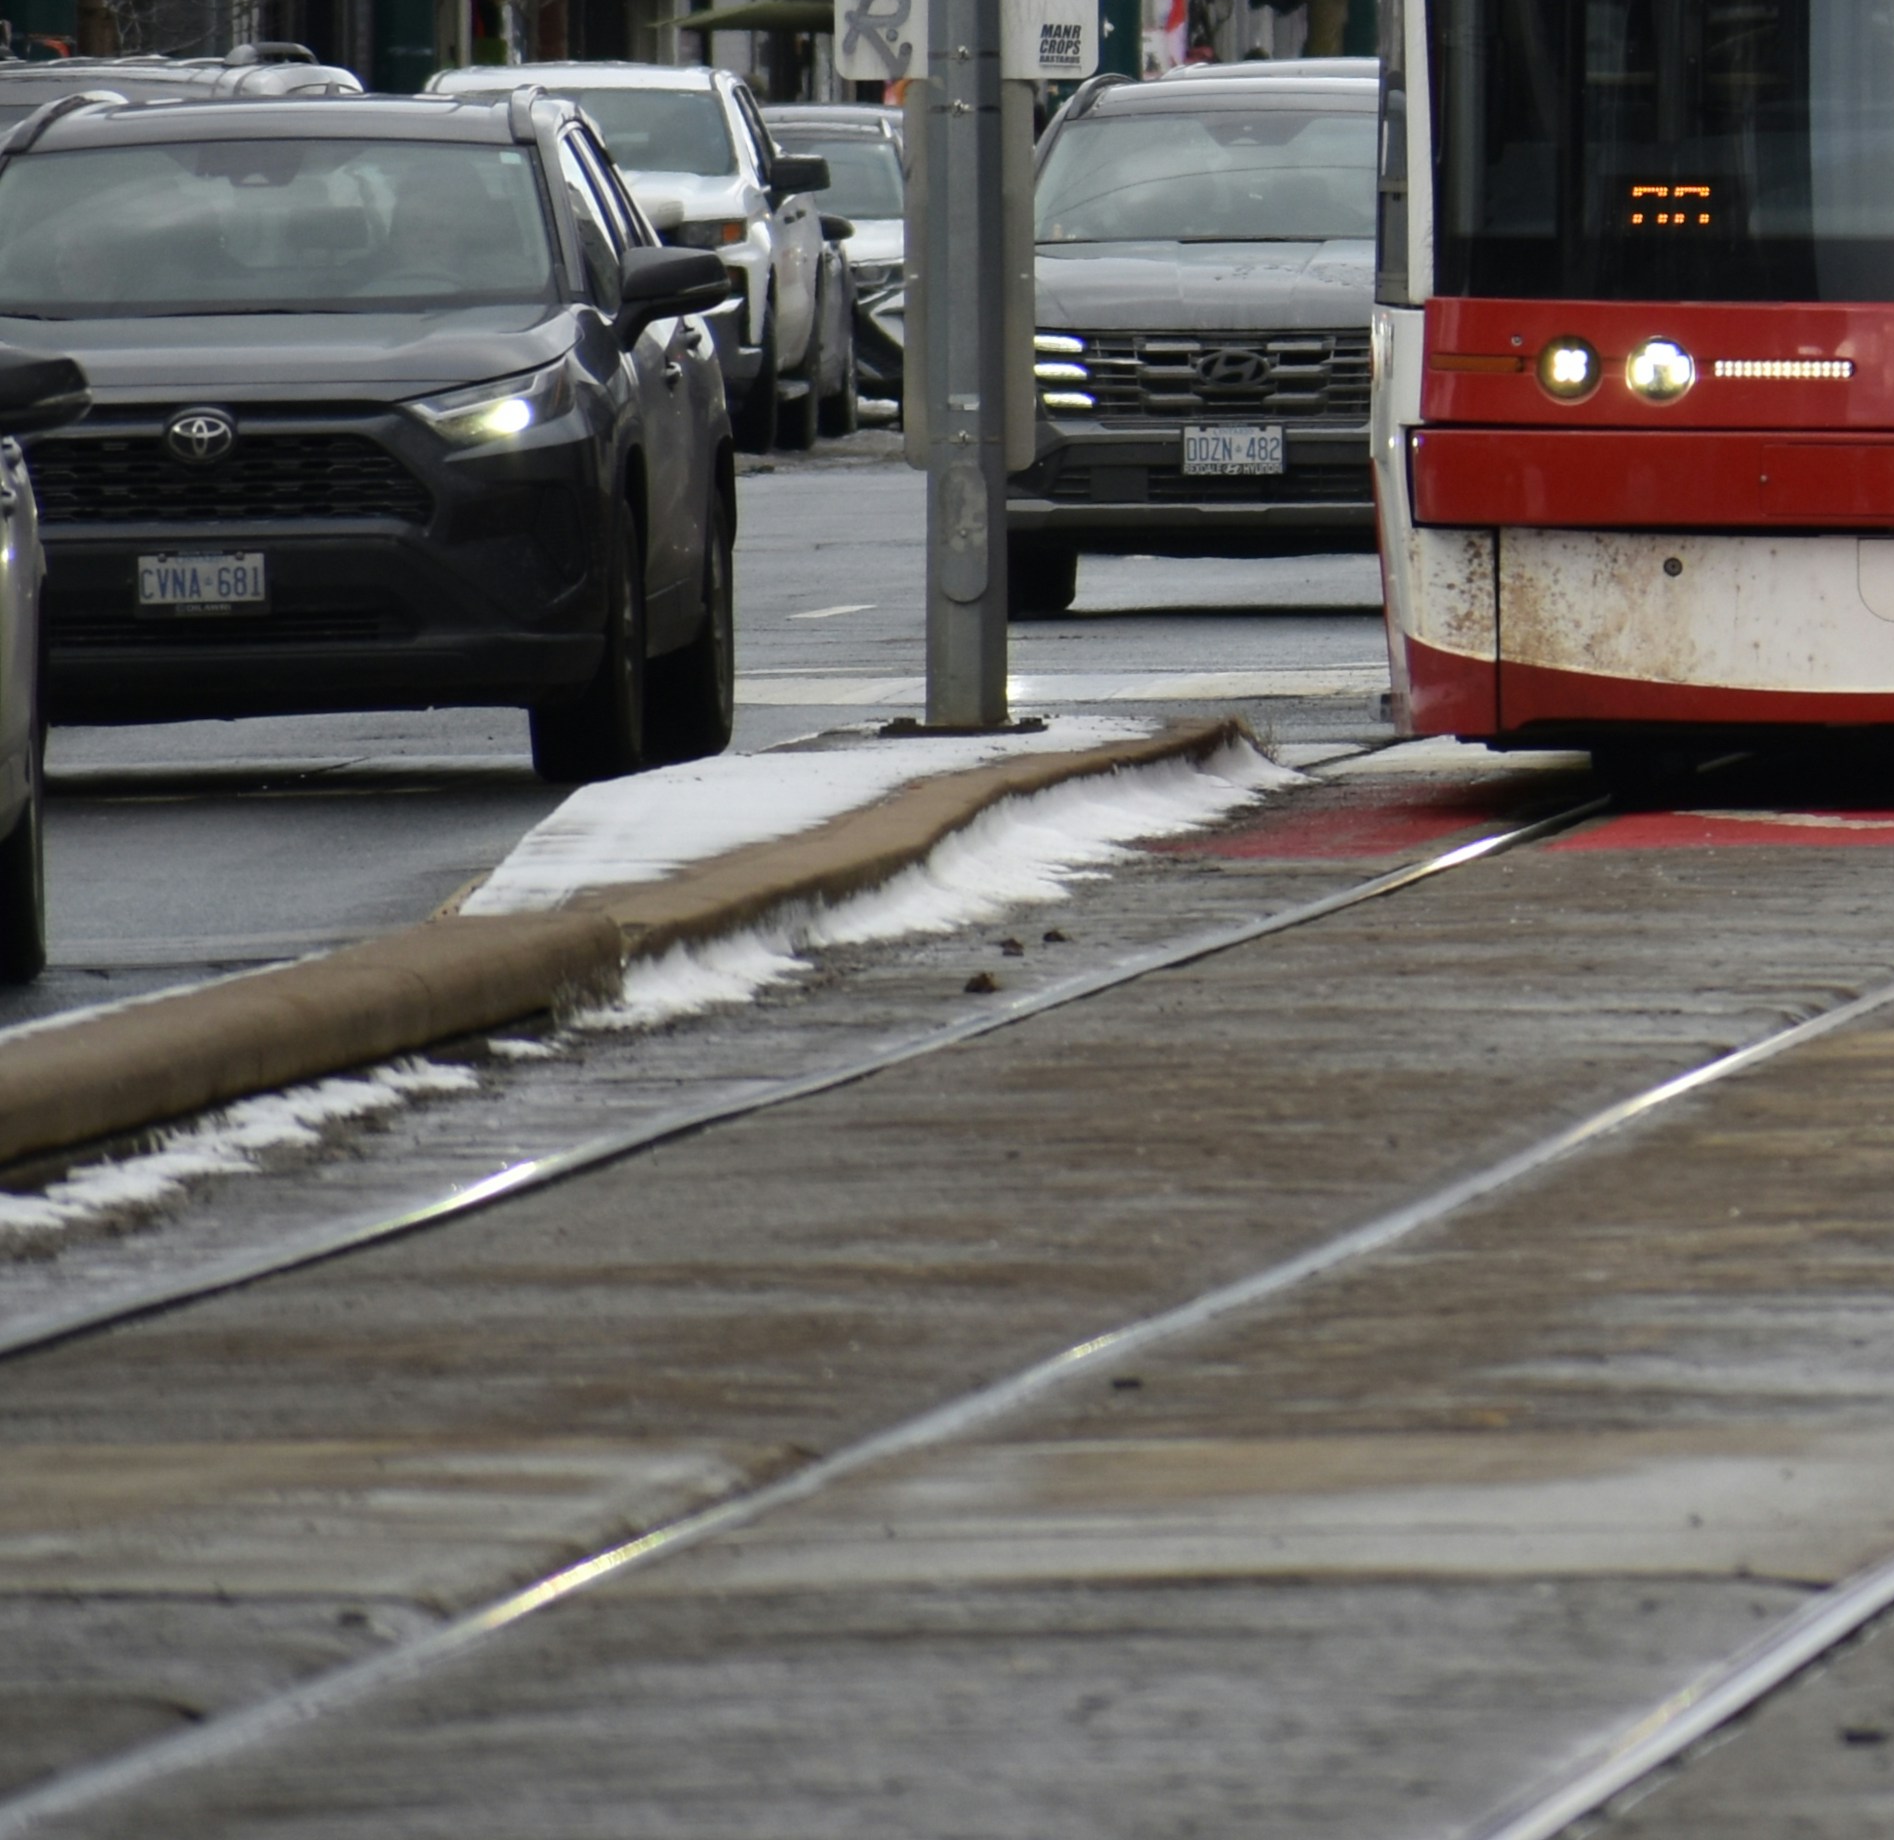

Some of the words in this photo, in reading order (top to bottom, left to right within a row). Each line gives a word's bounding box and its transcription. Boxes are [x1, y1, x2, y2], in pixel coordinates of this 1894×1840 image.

[1039, 39, 1082, 55] CROPS
[1246, 436, 1280, 462] 482
[141, 568, 202, 600] CVNA
[217, 566, 260, 598] 681
